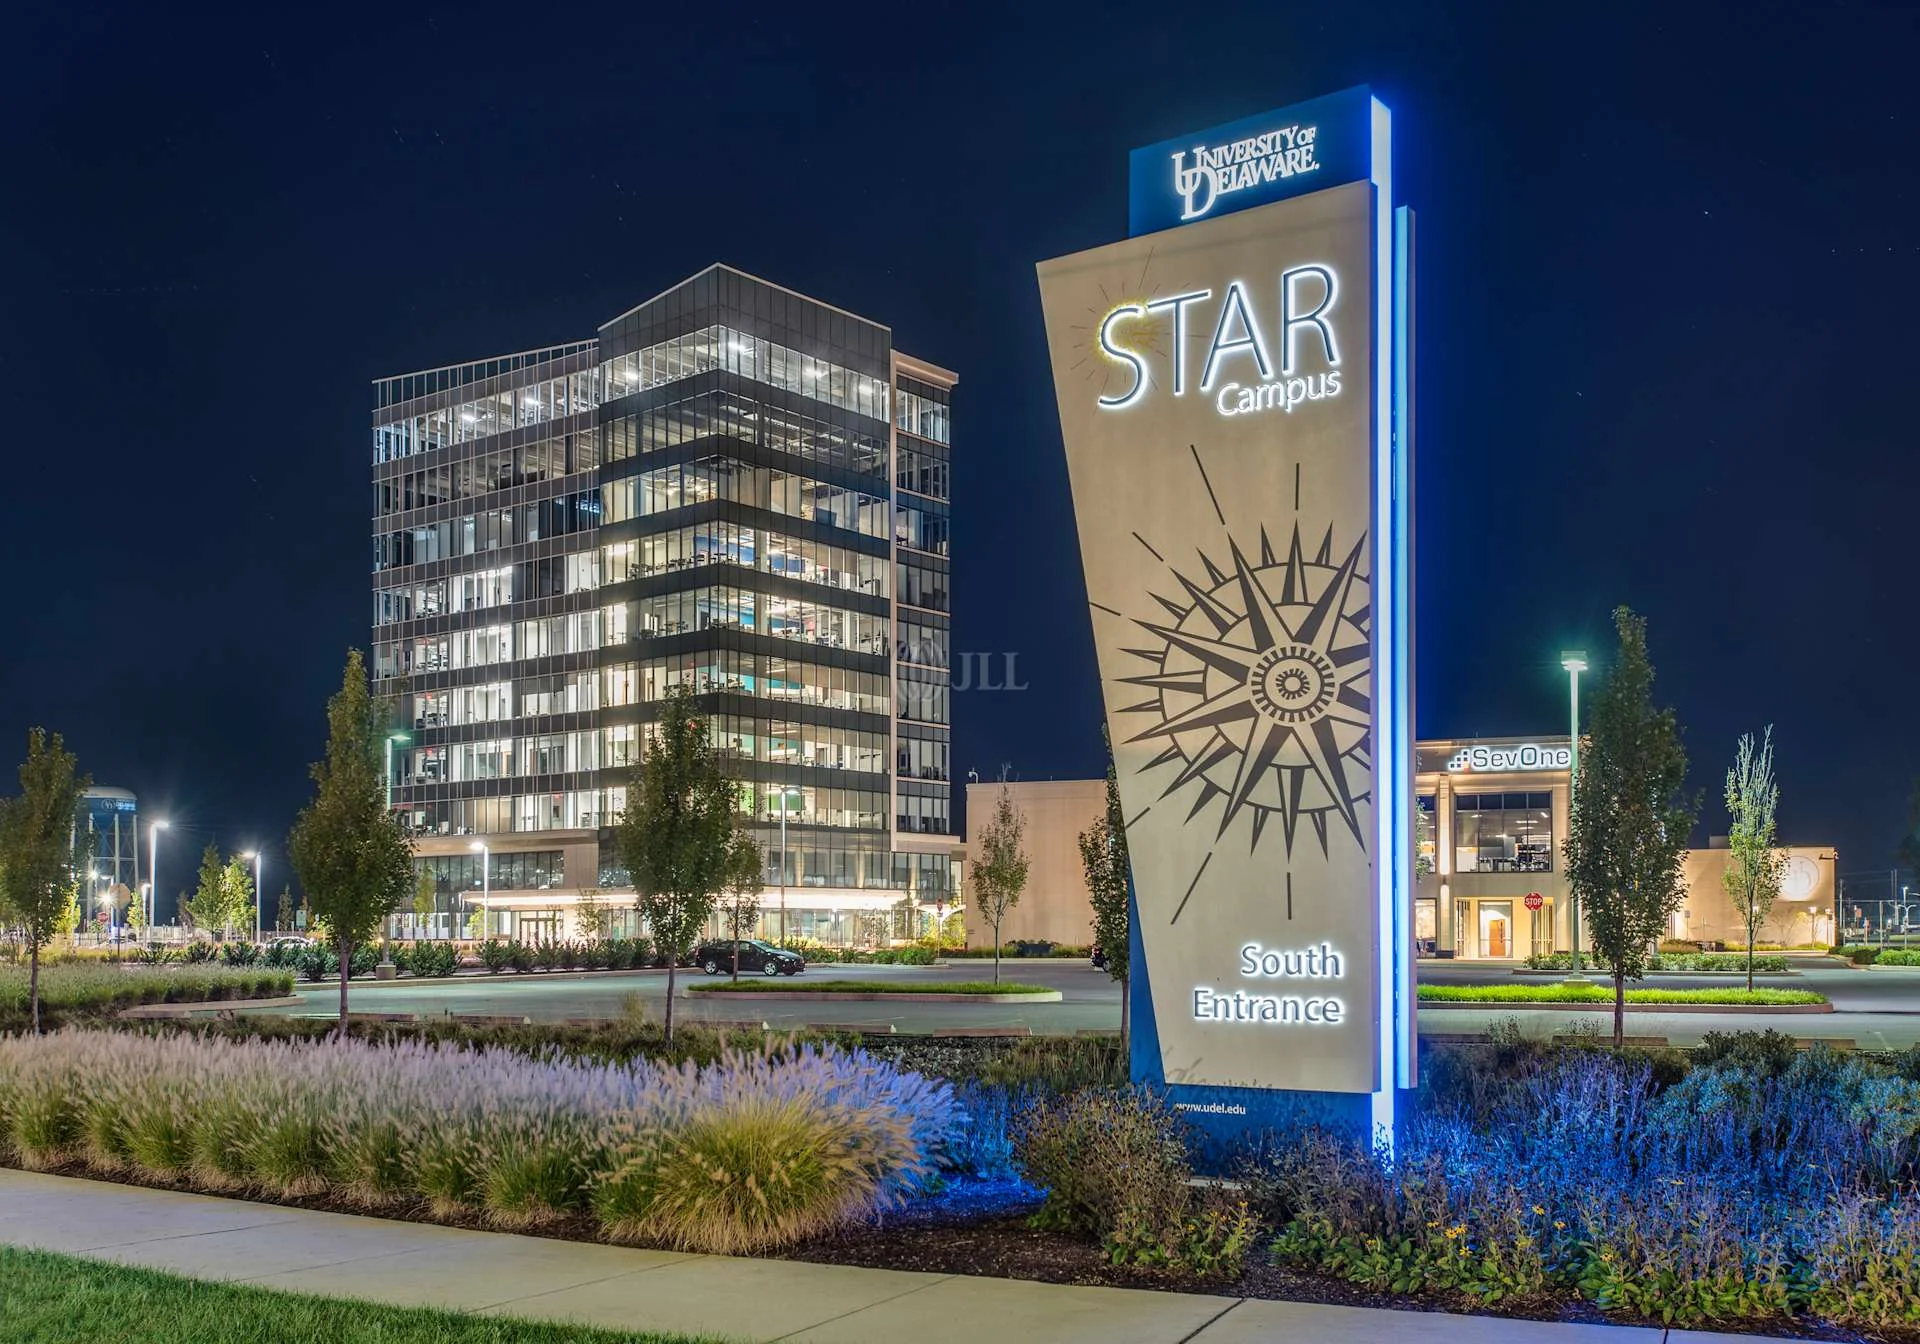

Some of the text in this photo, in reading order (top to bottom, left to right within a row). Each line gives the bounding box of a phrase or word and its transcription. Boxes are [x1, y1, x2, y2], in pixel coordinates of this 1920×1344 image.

[1171, 125, 1316, 196] UNIVERSITY OF
[1098, 262, 1340, 407] STAR
[1217, 370, 1342, 415] Campus
[1473, 747, 1569, 767] SevOne
[1526, 897, 1543, 906] STOP
[1241, 942, 1343, 976] South
[1194, 989, 1343, 1022] Entrance
[1175, 1102, 1246, 1115] www.udel.edu
